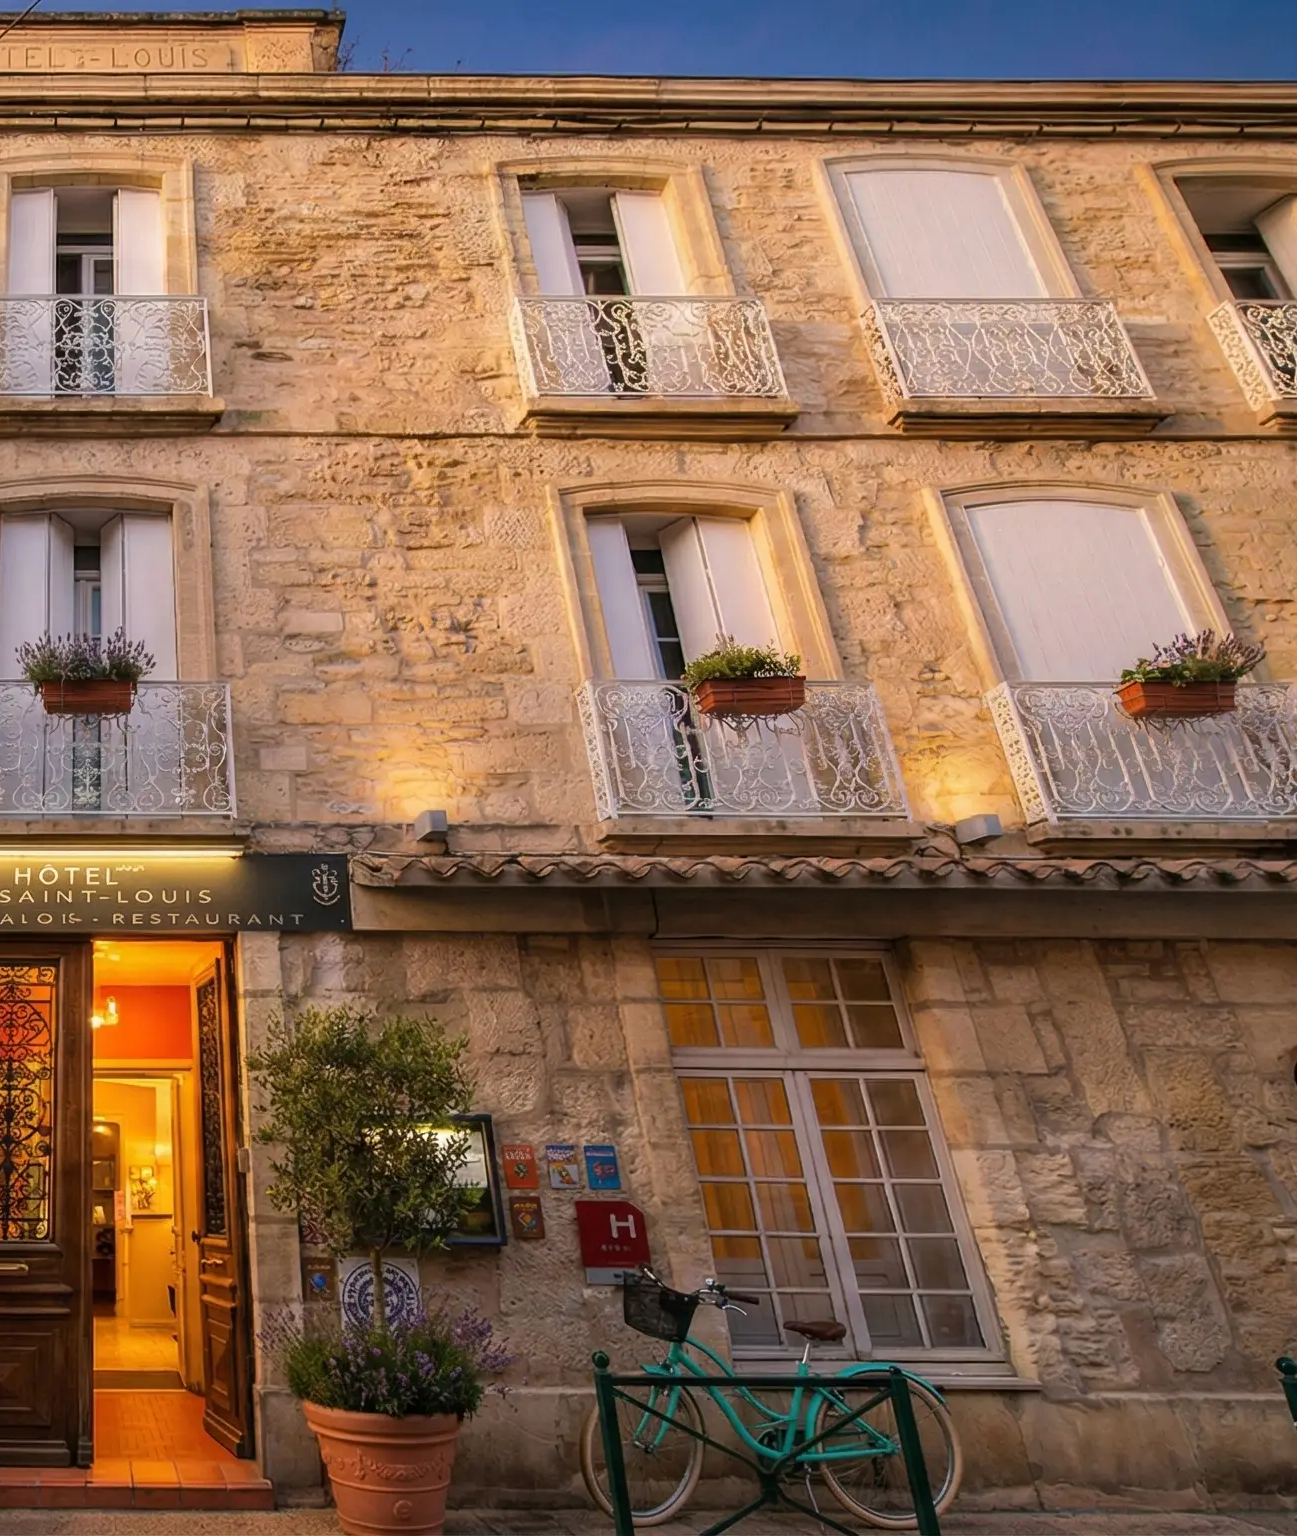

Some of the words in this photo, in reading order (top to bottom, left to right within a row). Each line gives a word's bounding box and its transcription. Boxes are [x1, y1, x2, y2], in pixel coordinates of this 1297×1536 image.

[14, 864, 119, 886] HÔTEL
[112, 912, 305, 926] RESTAURANT
[609, 1213, 637, 1239] H
